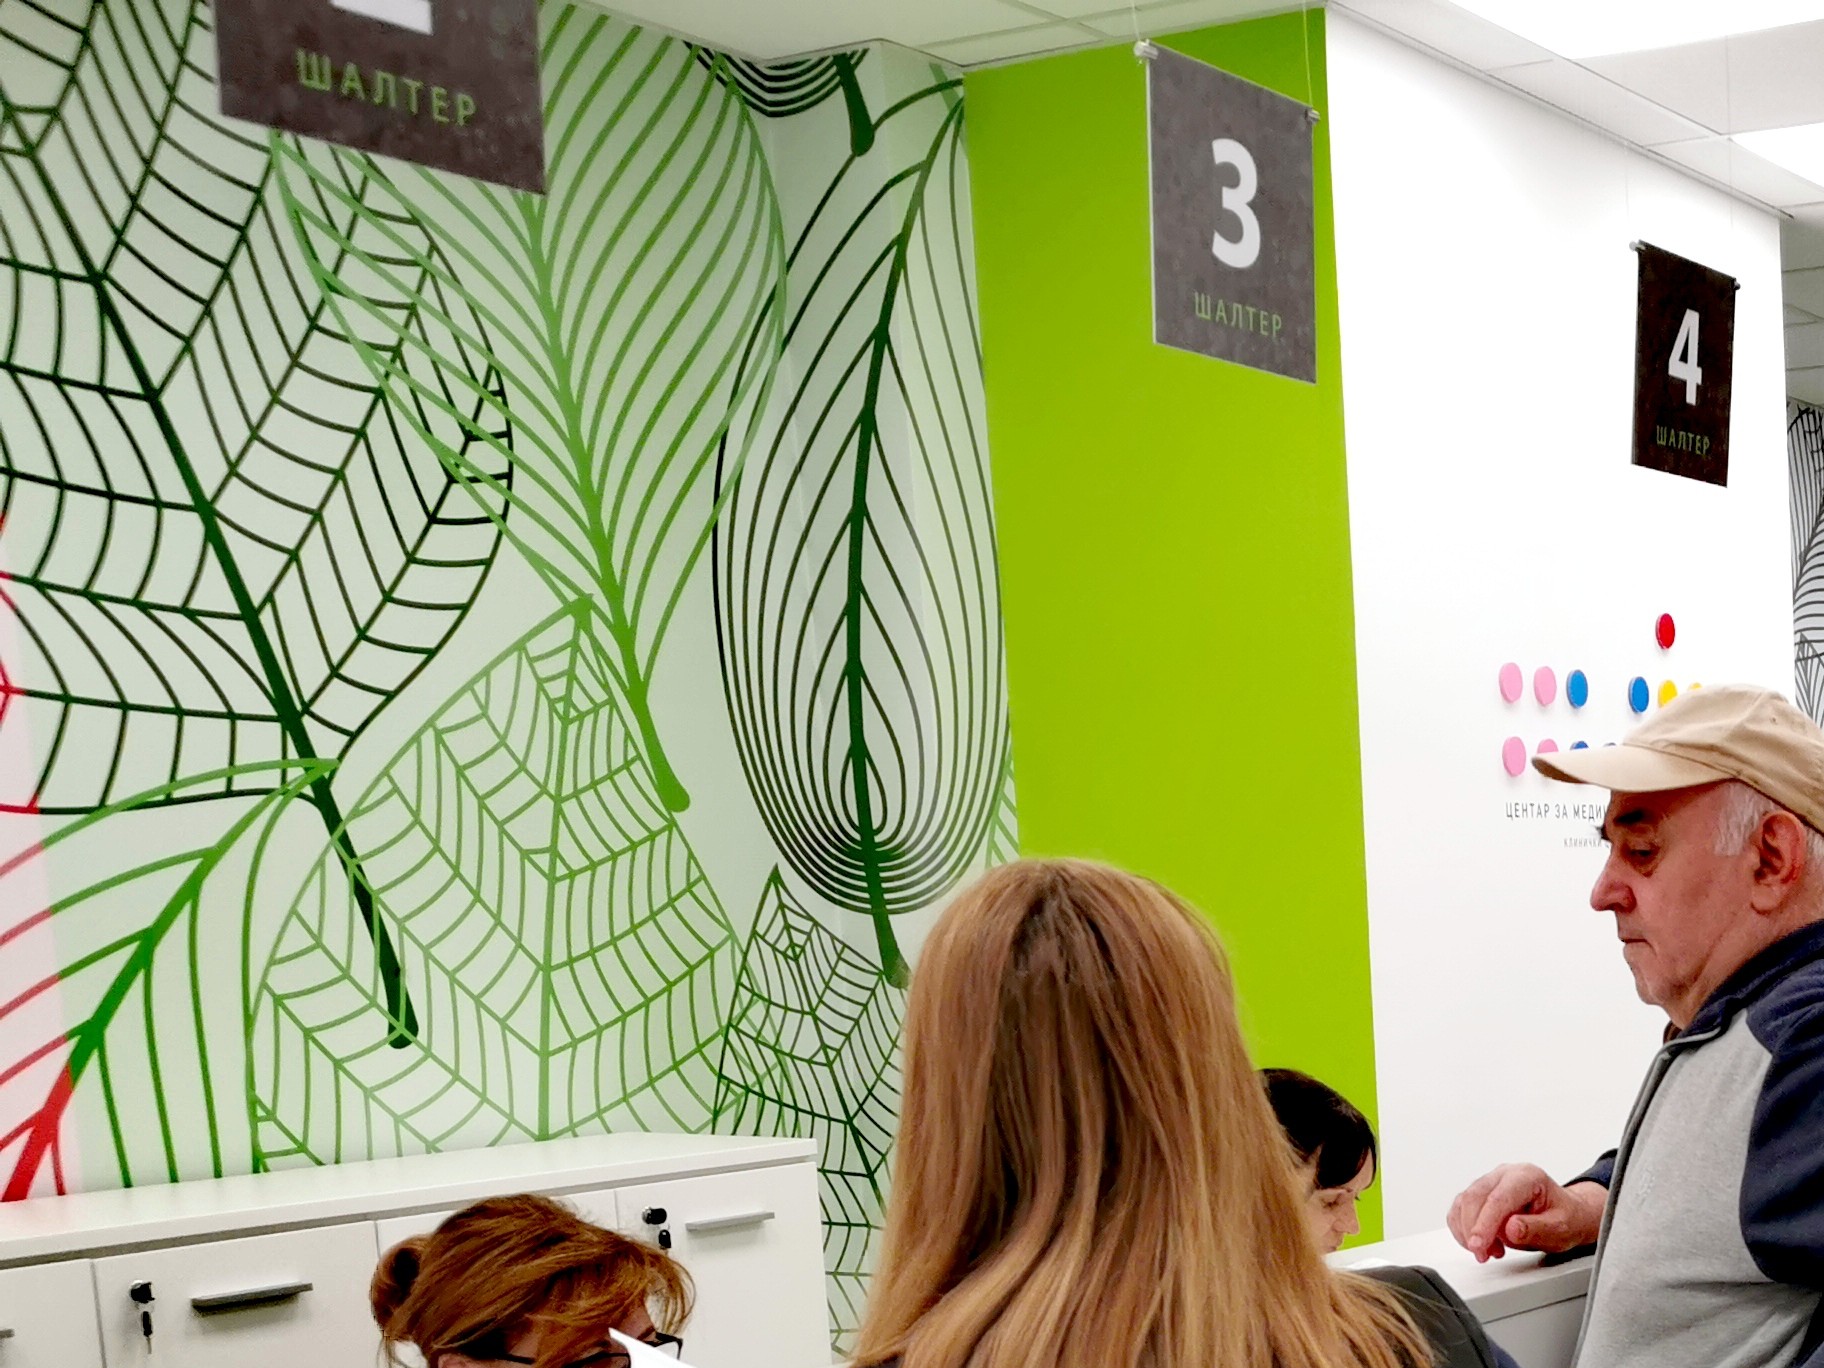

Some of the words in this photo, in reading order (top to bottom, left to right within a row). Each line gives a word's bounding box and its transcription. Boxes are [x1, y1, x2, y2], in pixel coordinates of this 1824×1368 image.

[297, 48, 477, 127] ШАЛТЕР
[1211, 138, 1261, 269] 3
[1194, 292, 1283, 338] ШАЛТЕР
[1668, 308, 1703, 406] 4
[1656, 424, 1710, 456] ШАЛТЕР
[1505, 802, 1550, 821] ЦЕНТАР
[1555, 804, 1568, 819] ЗА
